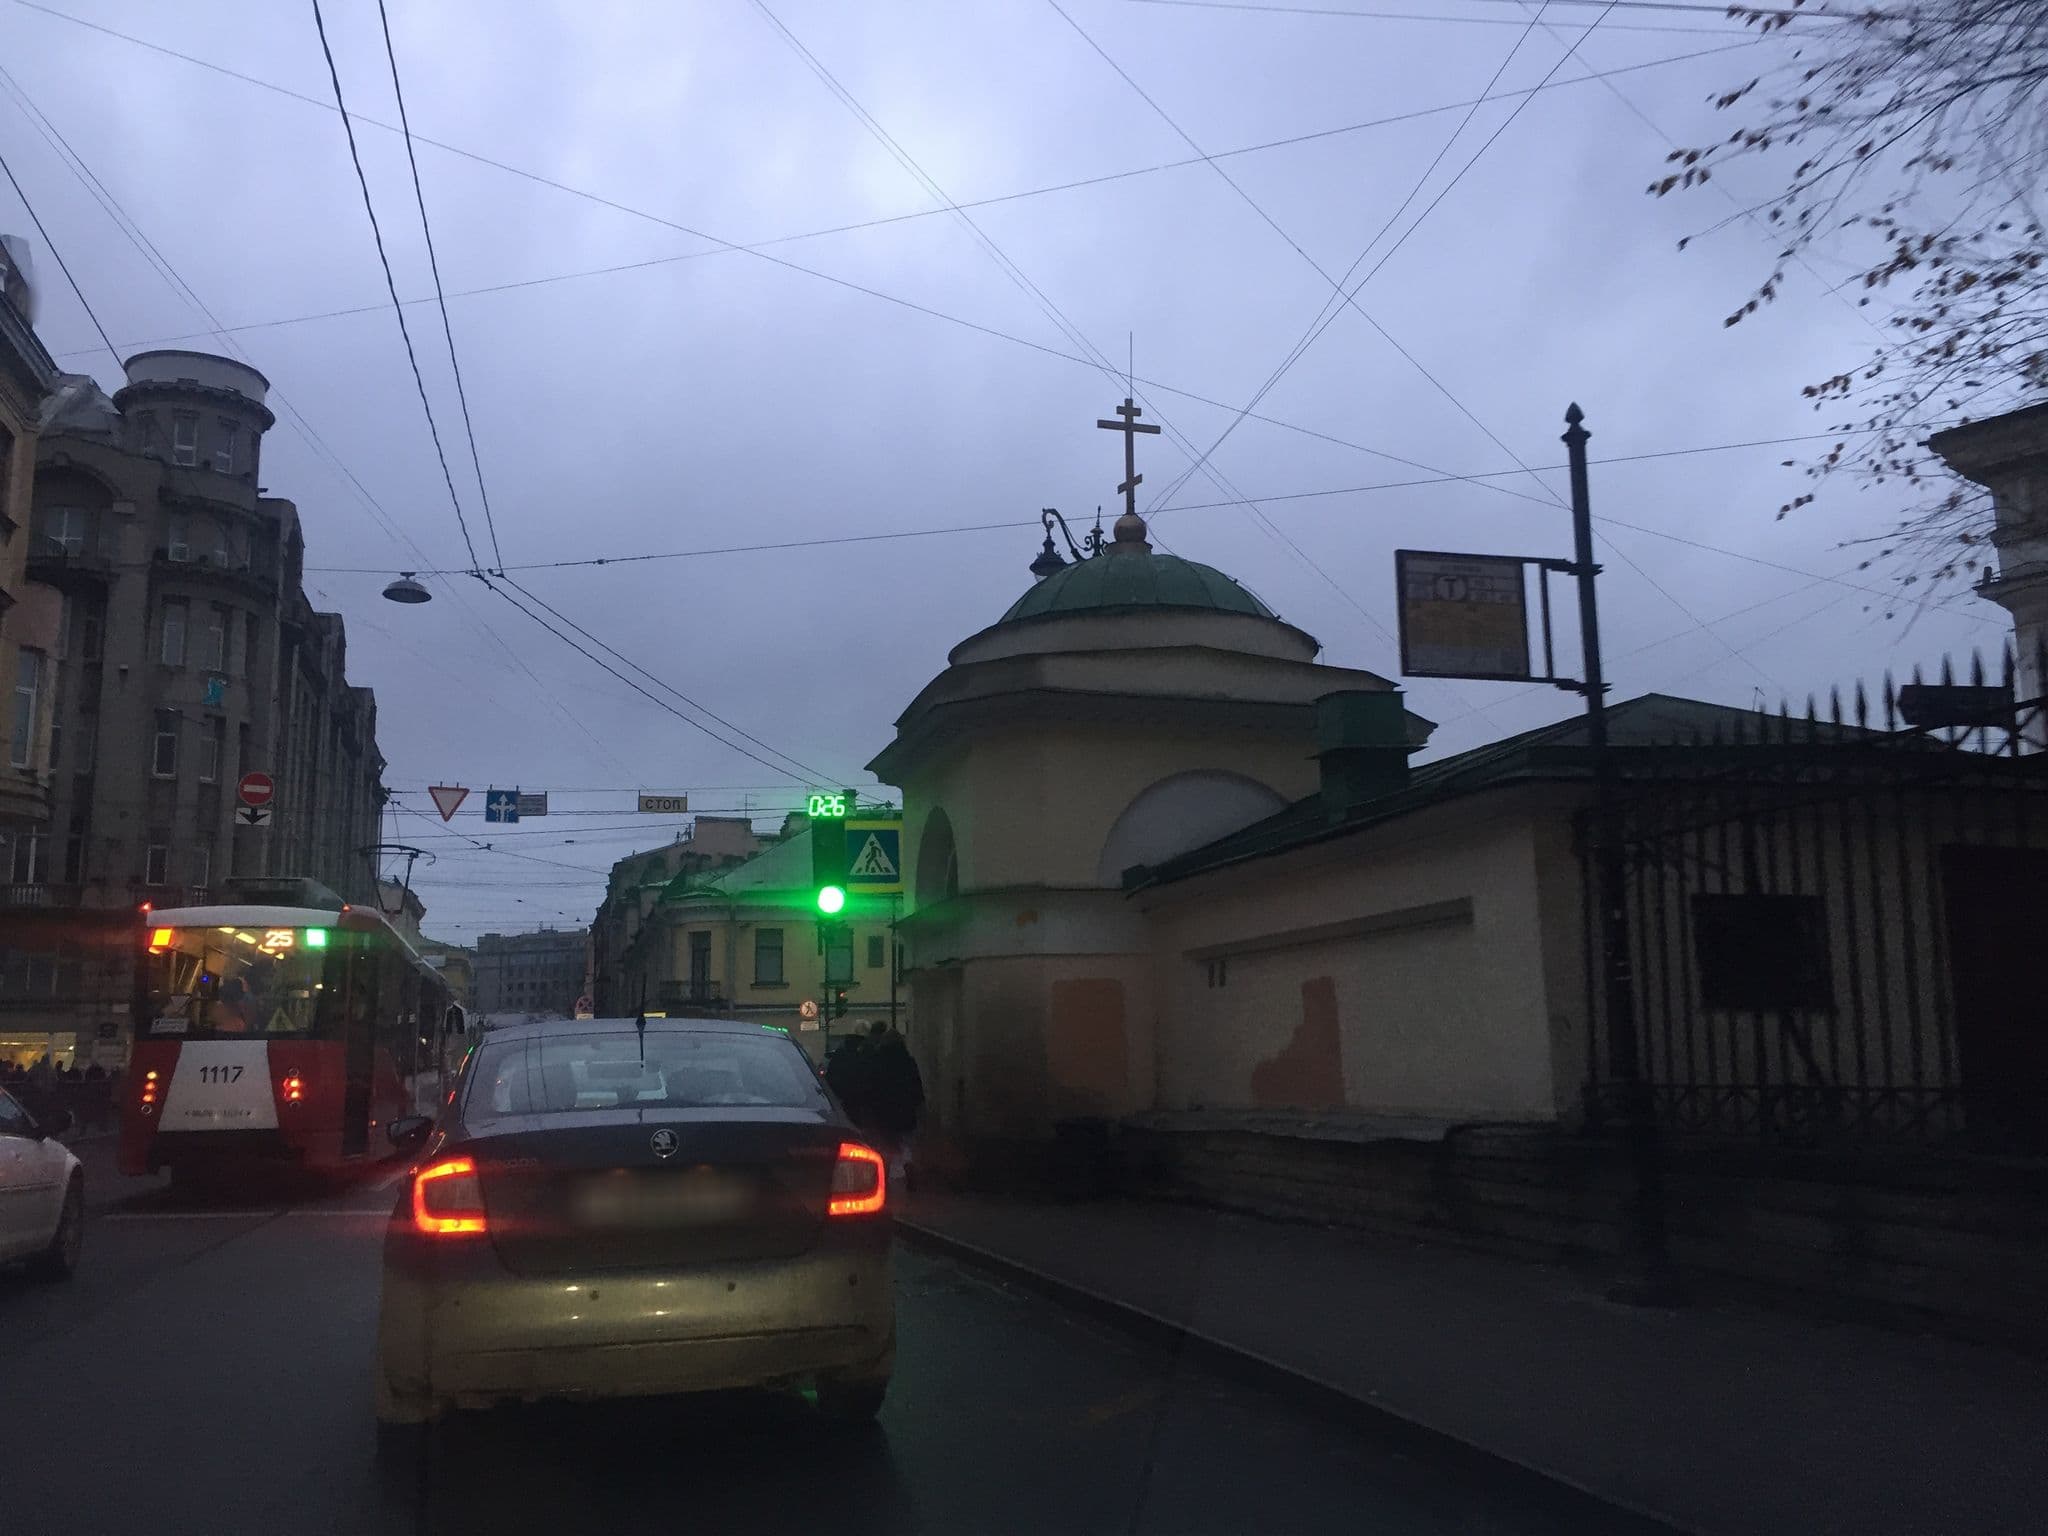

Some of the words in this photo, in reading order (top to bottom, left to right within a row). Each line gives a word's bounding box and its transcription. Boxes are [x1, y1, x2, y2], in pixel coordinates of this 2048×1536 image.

[645, 798, 681, 811] СТОП
[264, 925, 294, 947] 25
[200, 1065, 243, 1084] 1117
